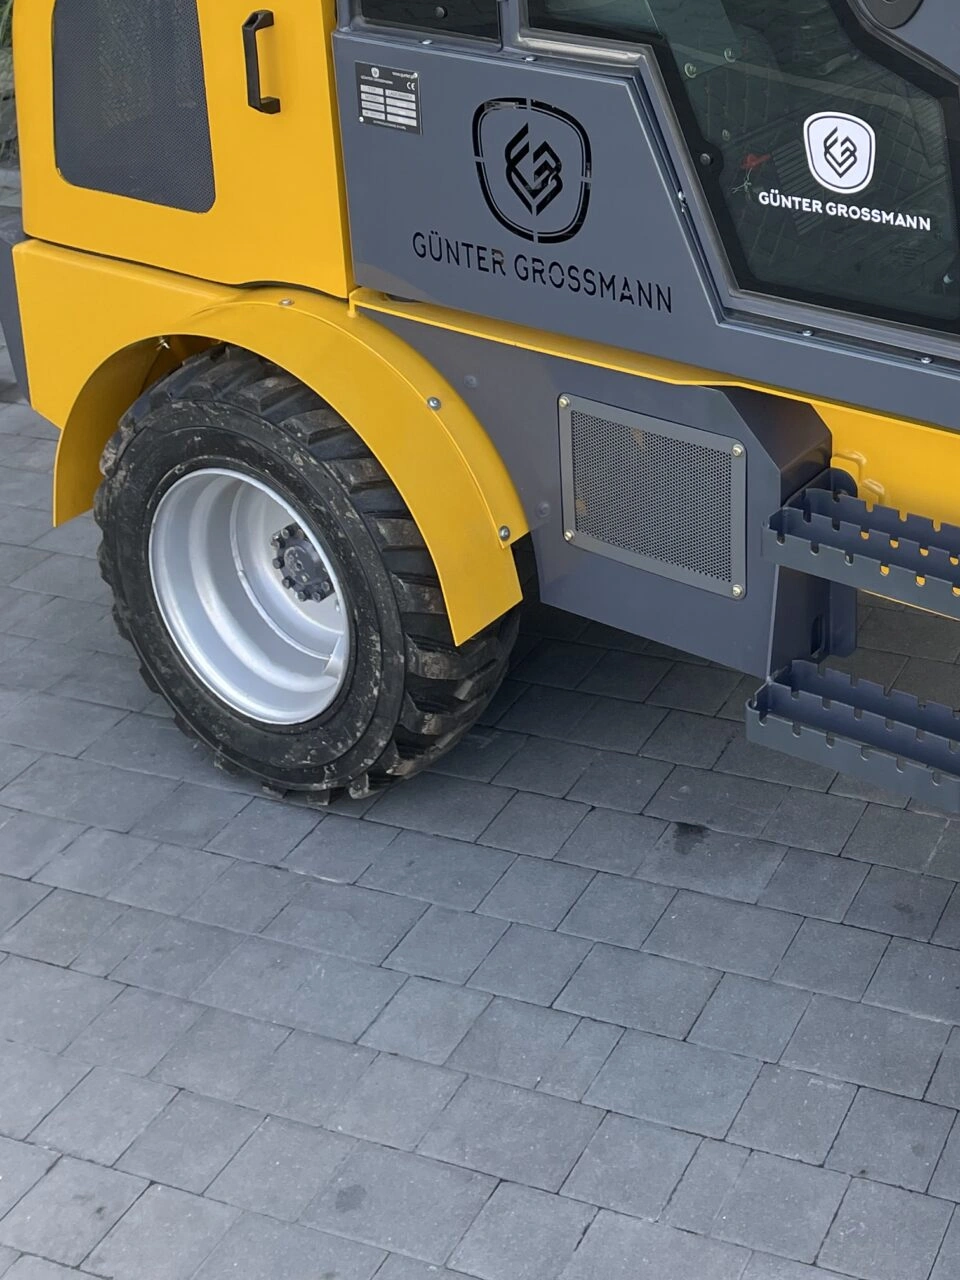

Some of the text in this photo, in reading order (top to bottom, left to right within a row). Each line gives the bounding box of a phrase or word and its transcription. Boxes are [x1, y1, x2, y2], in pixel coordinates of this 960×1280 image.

[758, 189, 931, 231] GÜNTER GROSSMANN
[412, 230, 672, 314] GÜNTER GROSSMANN
